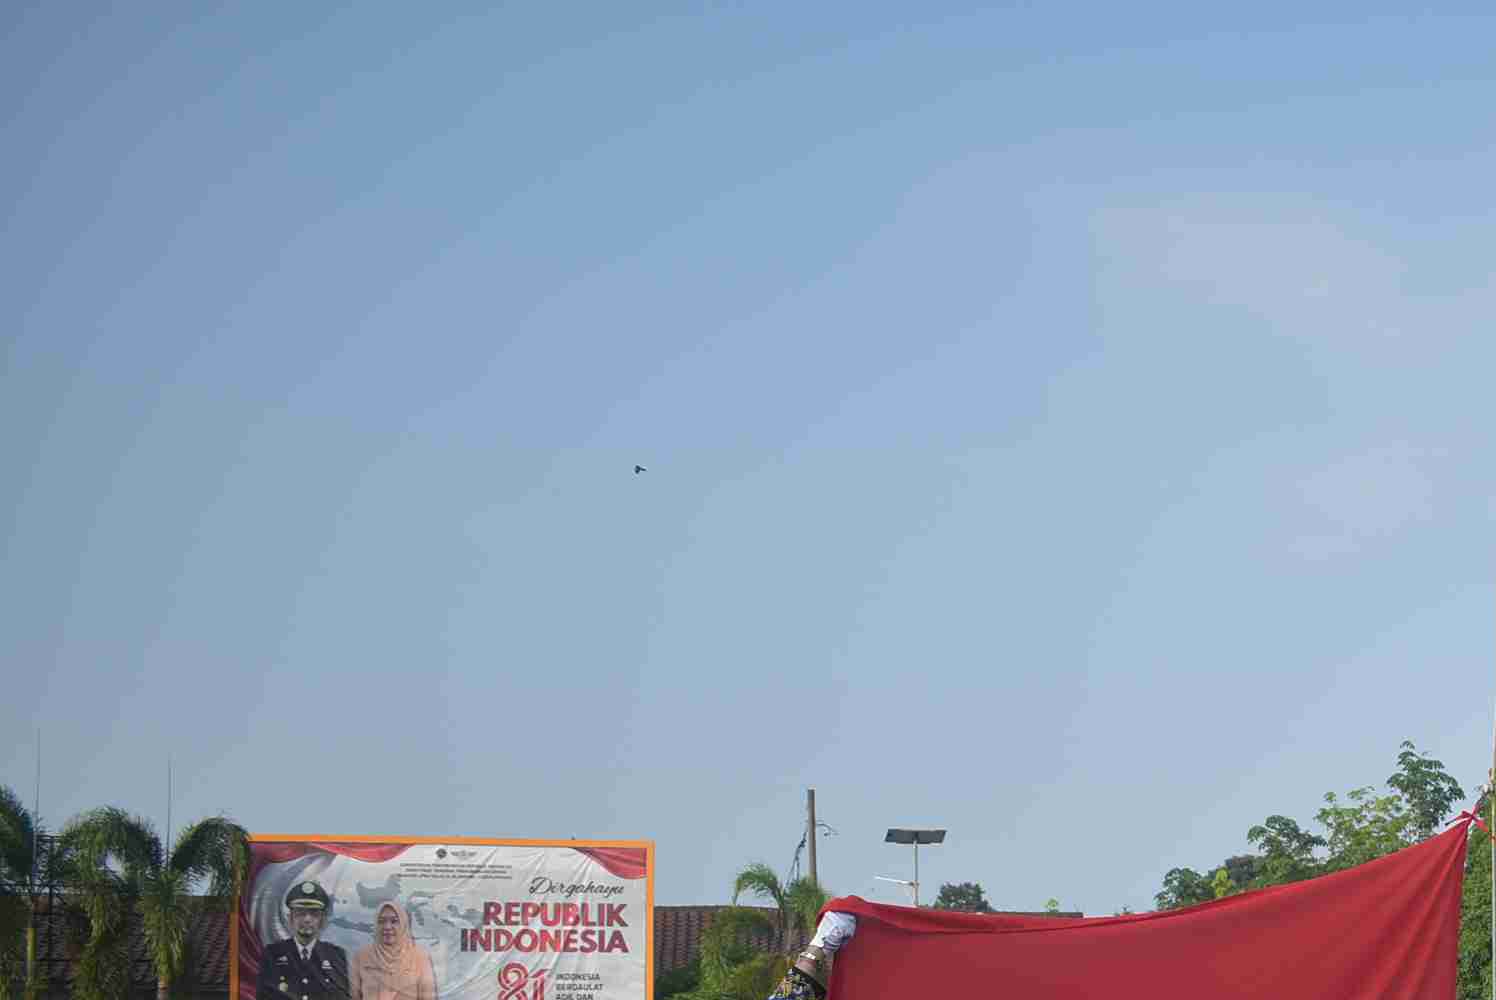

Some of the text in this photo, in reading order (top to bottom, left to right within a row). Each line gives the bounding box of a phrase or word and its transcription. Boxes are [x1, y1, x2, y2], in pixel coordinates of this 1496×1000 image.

[528, 876, 624, 898] Dirgahayu
[482, 901, 629, 927] REPUBLIK
[460, 928, 629, 953] INDONESIA
